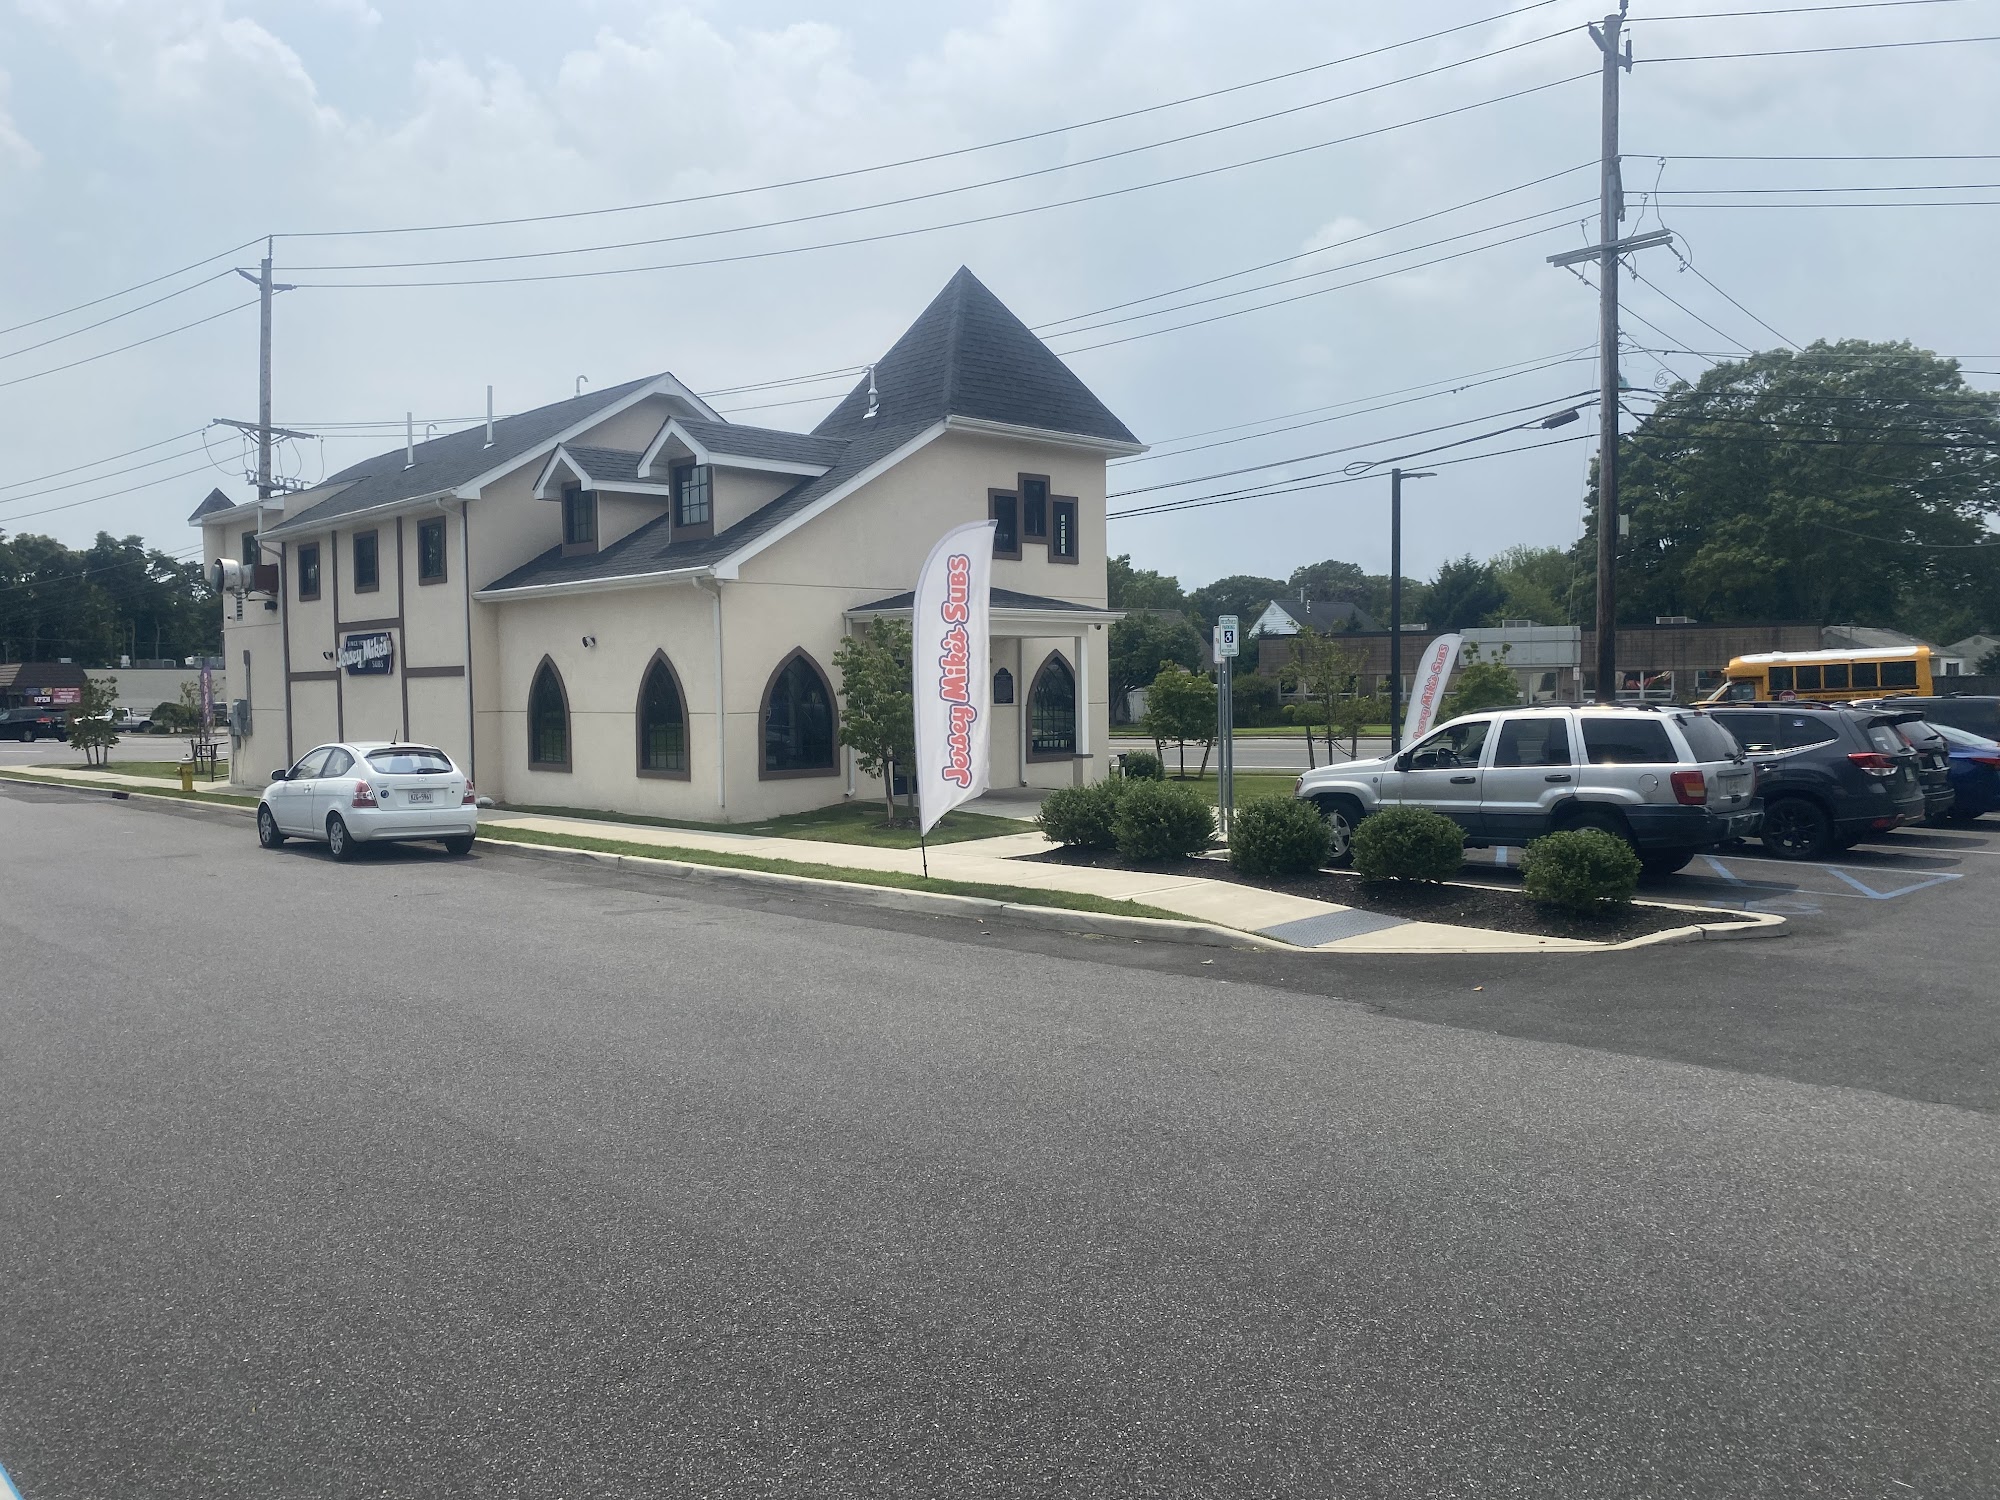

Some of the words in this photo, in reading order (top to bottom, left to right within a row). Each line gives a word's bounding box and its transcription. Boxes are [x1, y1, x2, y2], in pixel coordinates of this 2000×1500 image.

[337, 648, 363, 668] Jersey
[363, 636, 390, 660] Mike's
[372, 660, 384, 668] SUBS
[940, 622, 970, 704] Mike's
[942, 704, 977, 788] Jersey
